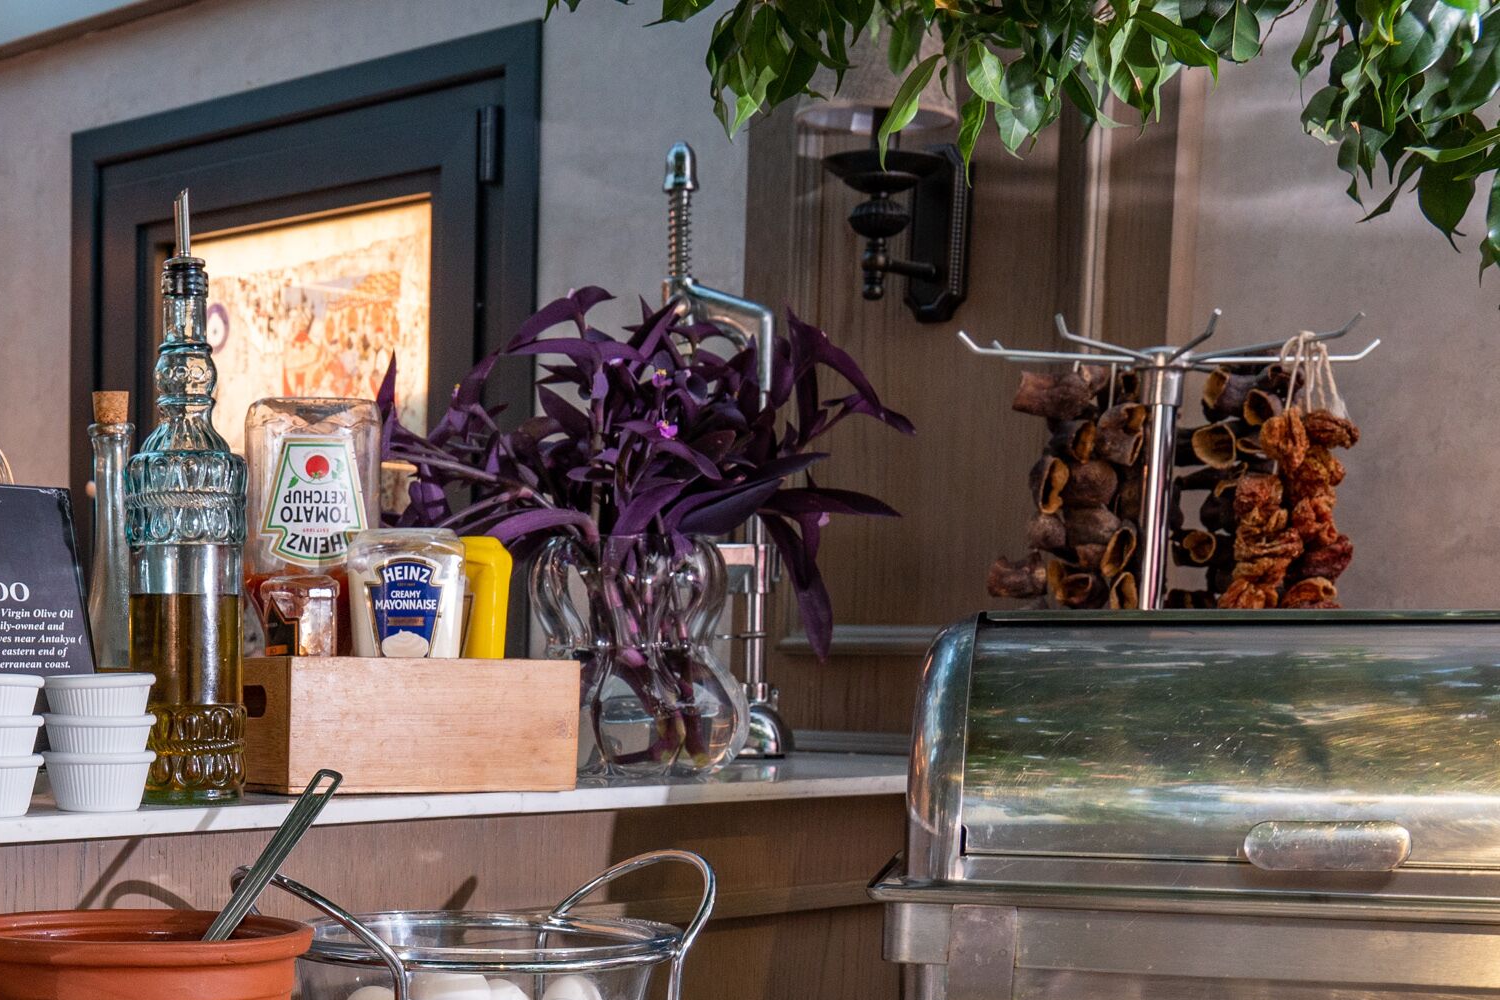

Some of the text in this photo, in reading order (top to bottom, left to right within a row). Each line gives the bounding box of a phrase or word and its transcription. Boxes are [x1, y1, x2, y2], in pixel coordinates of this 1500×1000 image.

[283, 490, 347, 504] KETCHUP
[280, 506, 351, 524] TOMATO
[286, 533, 344, 554] HEINZ
[382, 565, 431, 584] HEINZ
[390, 590, 421, 599] CREAMY
[375, 599, 437, 610] MAYONNAISE
[0, 608, 30, 619] Virgin
[33, 608, 57, 619] Olive
[59, 609, 74, 619] Oil
[47, 622, 65, 631] and
[14, 635, 36, 644] near
[37, 634, 76, 646] Antakya
[1, 647, 36, 656] eastern
[38, 647, 55, 656] end
[57, 646, 68, 658] of
[44, 660, 71, 669] coast.
